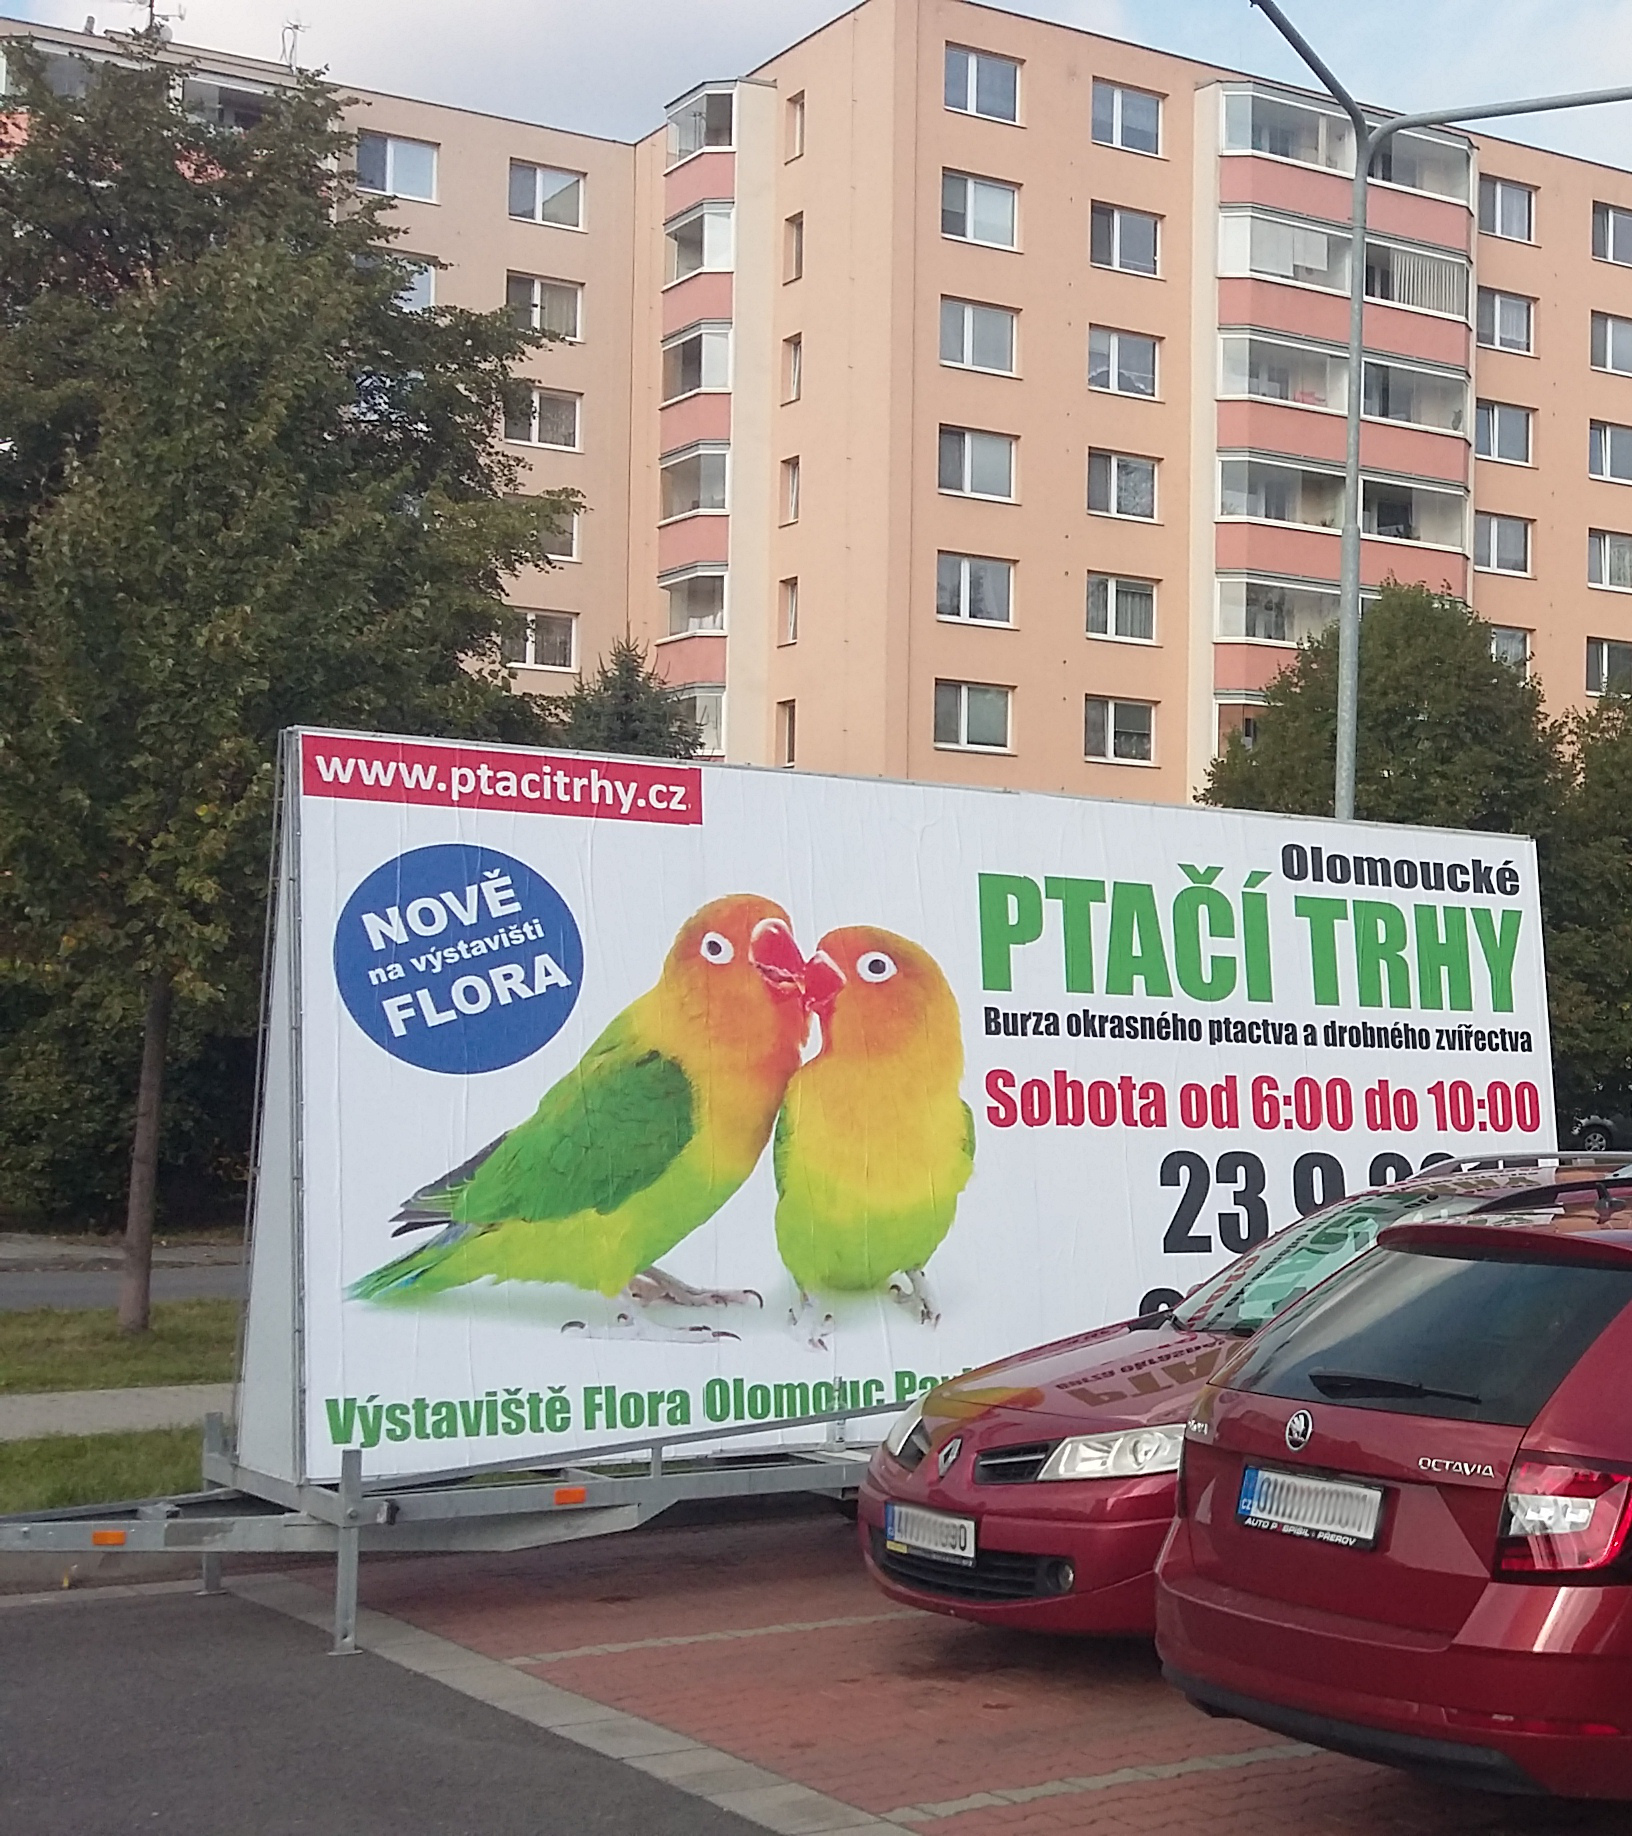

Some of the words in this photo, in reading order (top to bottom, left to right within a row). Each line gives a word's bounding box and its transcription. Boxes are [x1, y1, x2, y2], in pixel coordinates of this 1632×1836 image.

[315, 755, 689, 813] www.ptacitrhy.cz
[1281, 843, 1520, 895] Olomoucké
[361, 868, 522, 951] NOVĚ
[977, 863, 1273, 1003] PTAČÍ
[1294, 895, 1523, 1013] TRHY
[367, 963, 406, 986] na
[409, 918, 544, 974] výstavišti
[381, 952, 572, 1038] FLORA
[984, 1006, 1060, 1038] Burza
[1067, 1010, 1202, 1043] okrasného
[1208, 1020, 1299, 1047] ptactva
[1303, 1026, 1318, 1047] a
[1323, 1021, 1431, 1051] drobného
[1435, 1025, 1533, 1053] zvířectva
[984, 1069, 1168, 1130] Sobota
[1179, 1075, 1239, 1130] od
[1251, 1075, 1354, 1133] 6:00
[1364, 1079, 1419, 1133] do
[1427, 1080, 1541, 1133] 10:00
[326, 1386, 571, 1448] Výstaviště
[583, 1385, 691, 1431] Flora
[704, 1371, 885, 1421] Olomouc
[1418, 1457, 1495, 1479] OCTAVIA
[1244, 1517, 1270, 1529] AUTO
